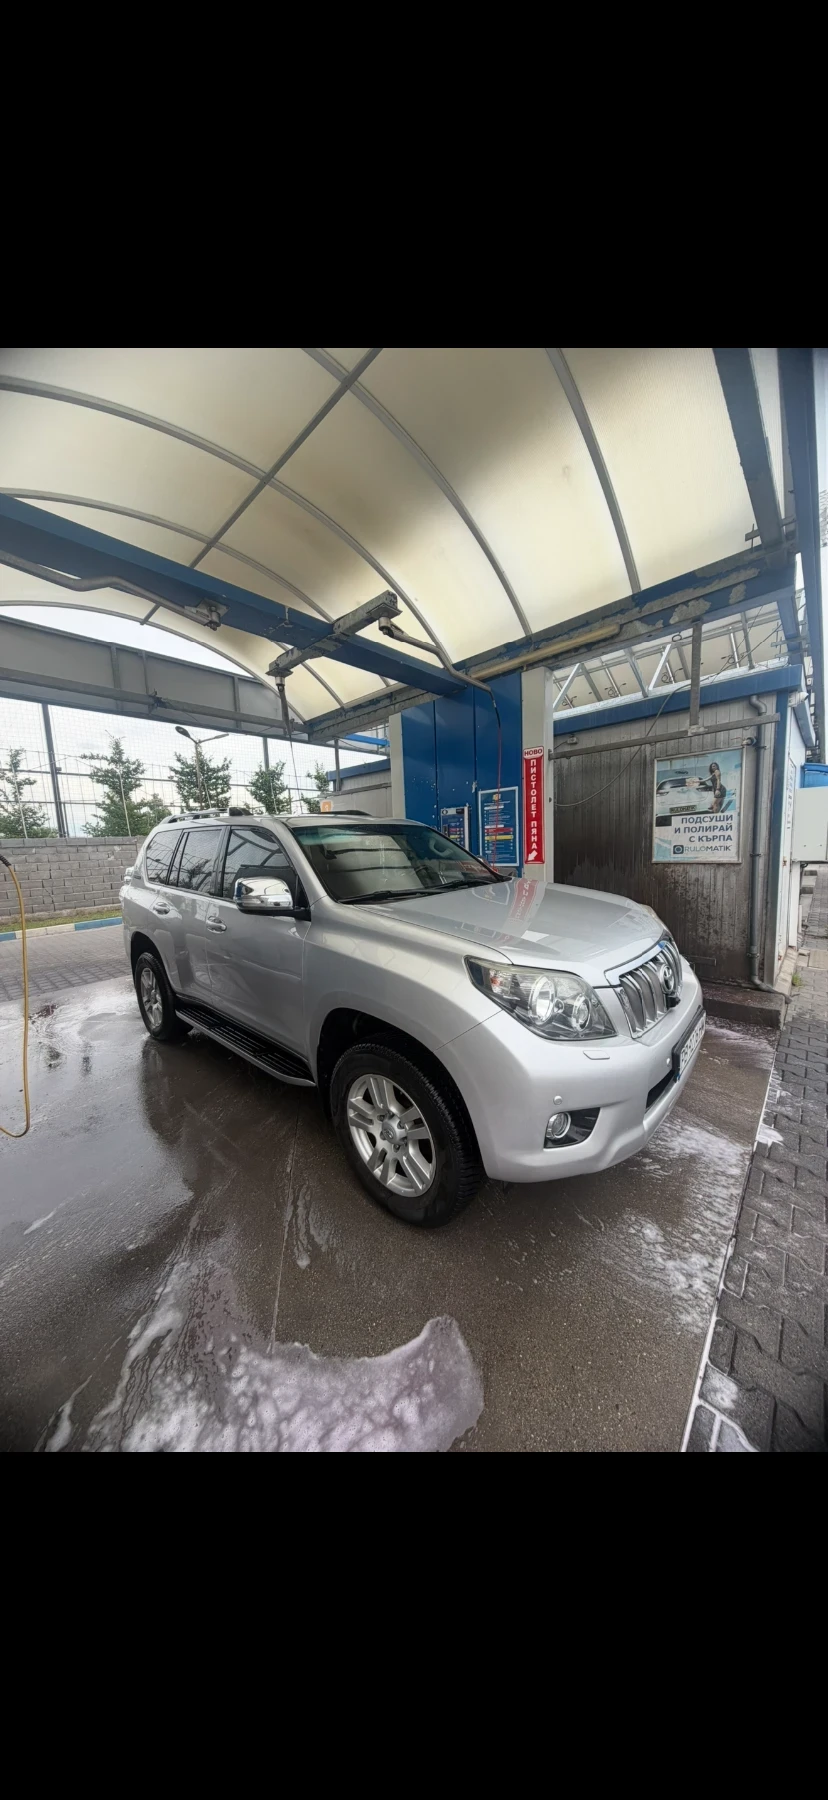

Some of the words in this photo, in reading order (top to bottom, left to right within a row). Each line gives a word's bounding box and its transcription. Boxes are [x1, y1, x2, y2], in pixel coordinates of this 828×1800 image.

[524, 748, 543, 757] НОВО
[681, 814, 733, 824] ПОДСУШИ
[683, 822, 733, 834] ПОЛИРАЙ
[530, 820, 538, 850] ПЯНА
[698, 834, 733, 842] КЪРПА
